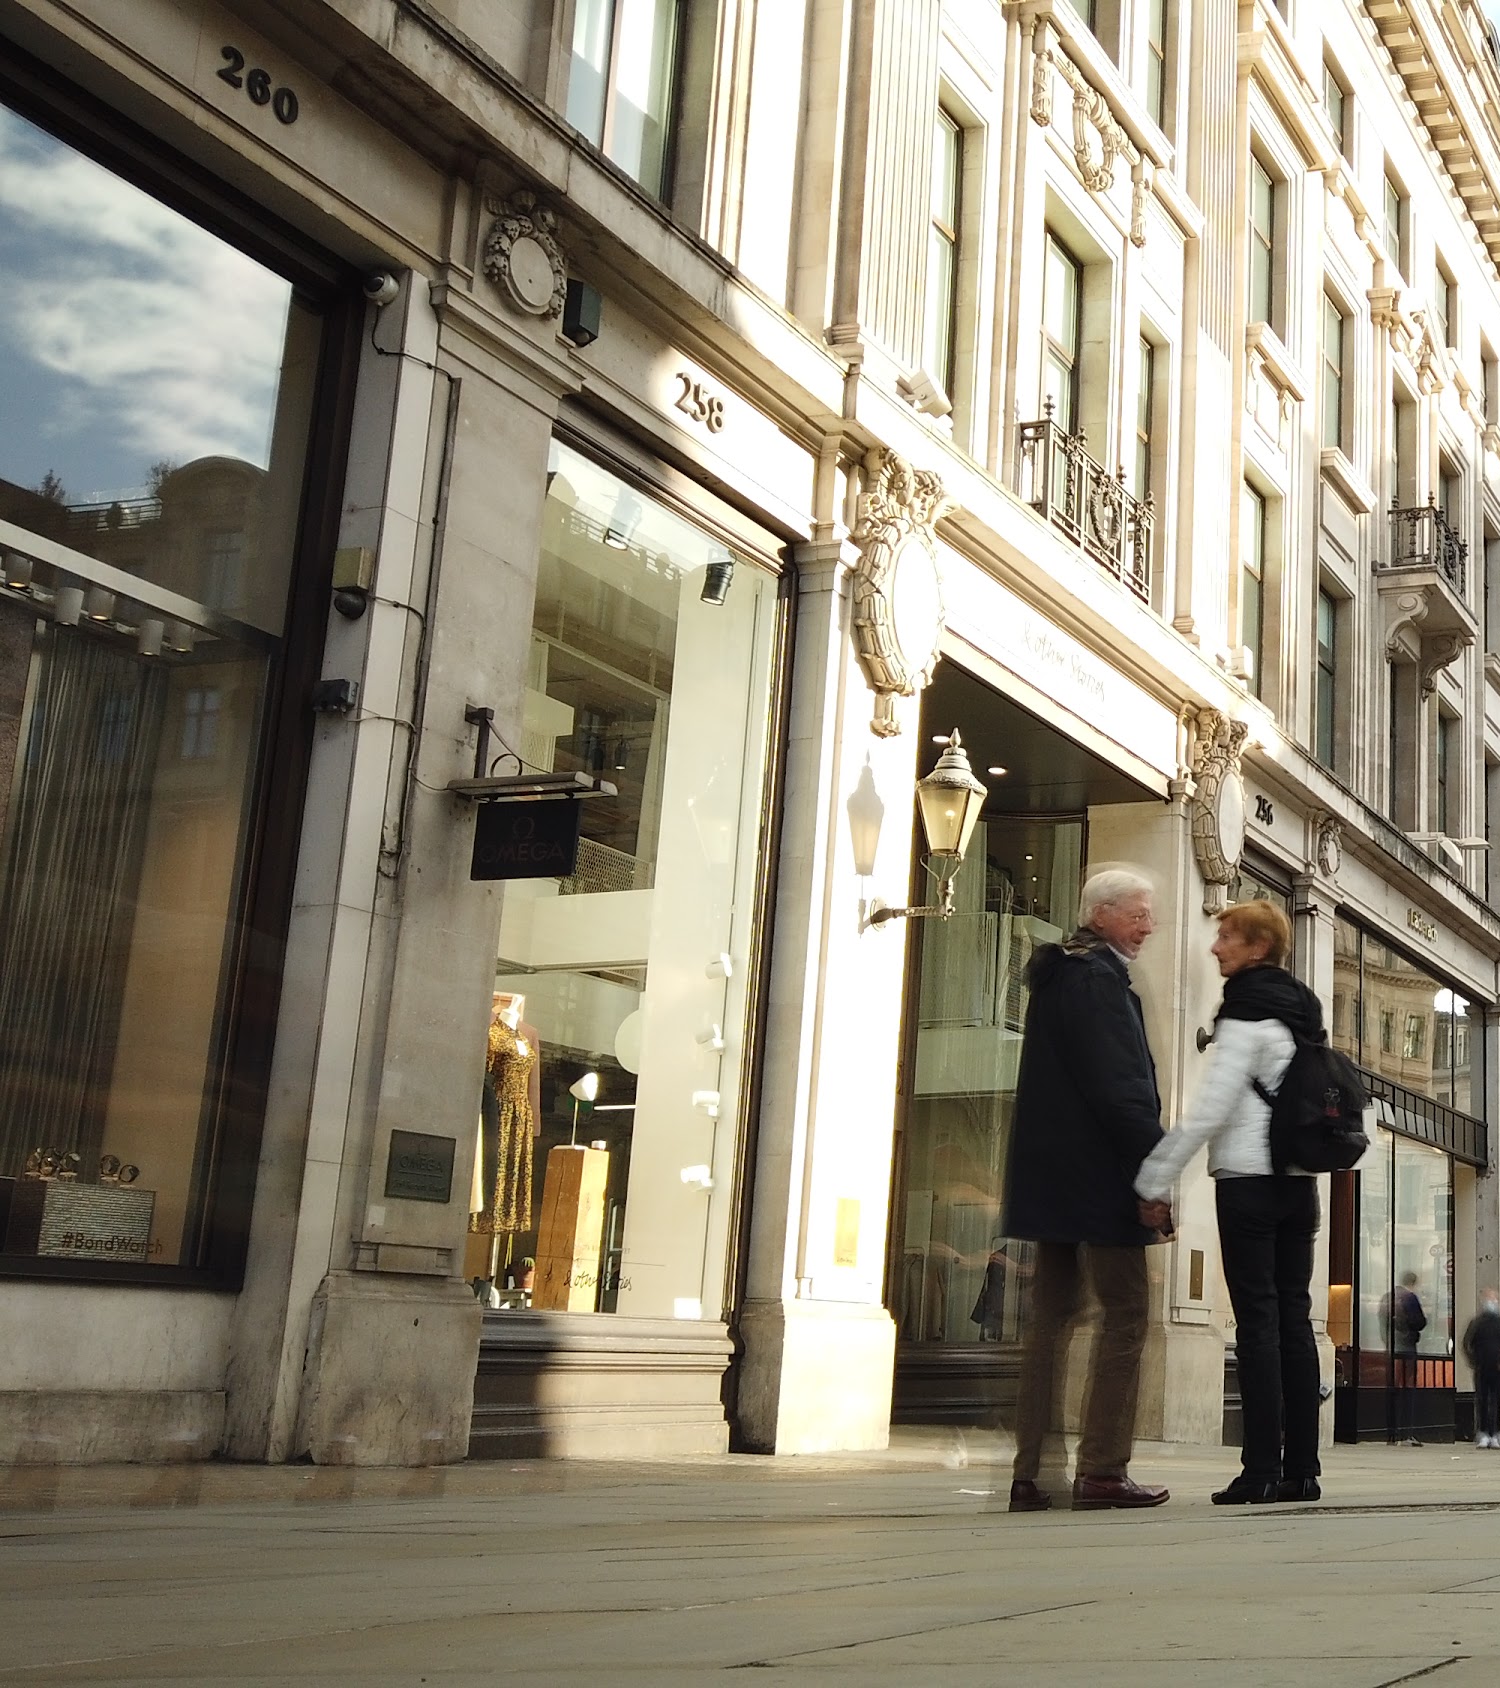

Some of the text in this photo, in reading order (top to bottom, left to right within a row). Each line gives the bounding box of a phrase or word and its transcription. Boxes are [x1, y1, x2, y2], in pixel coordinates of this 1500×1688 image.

[217, 46, 298, 125] 260
[674, 372, 724, 433] 258
[1255, 795, 1273, 826] 256
[480, 841, 565, 863] OMEGA
[61, 1231, 163, 1254] #BondWatch
